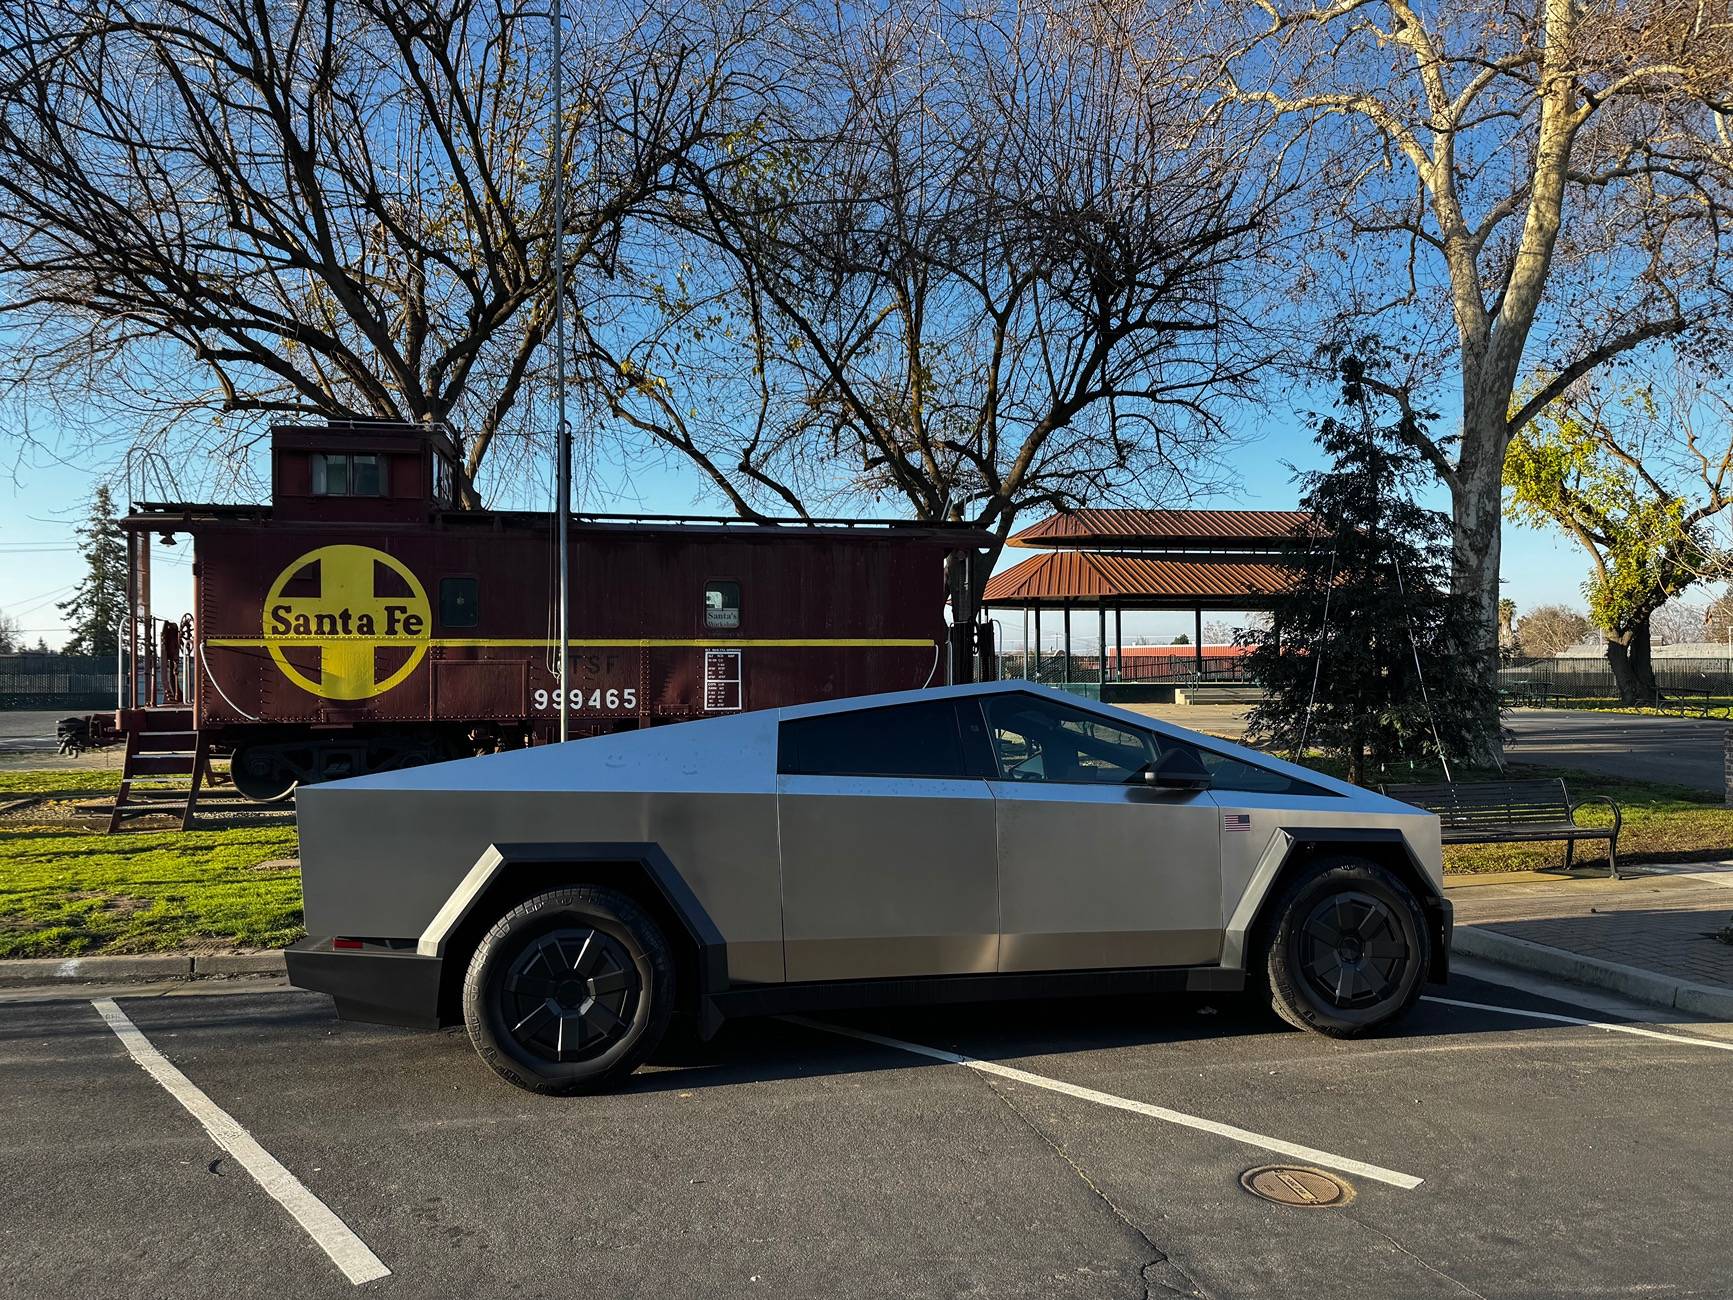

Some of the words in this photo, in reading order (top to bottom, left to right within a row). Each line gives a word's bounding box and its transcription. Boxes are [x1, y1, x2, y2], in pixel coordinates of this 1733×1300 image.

[271, 604, 375, 636] Santa
[384, 605, 424, 636] Fe
[707, 612, 737, 621] Santa's
[534, 688, 637, 710] 999465
